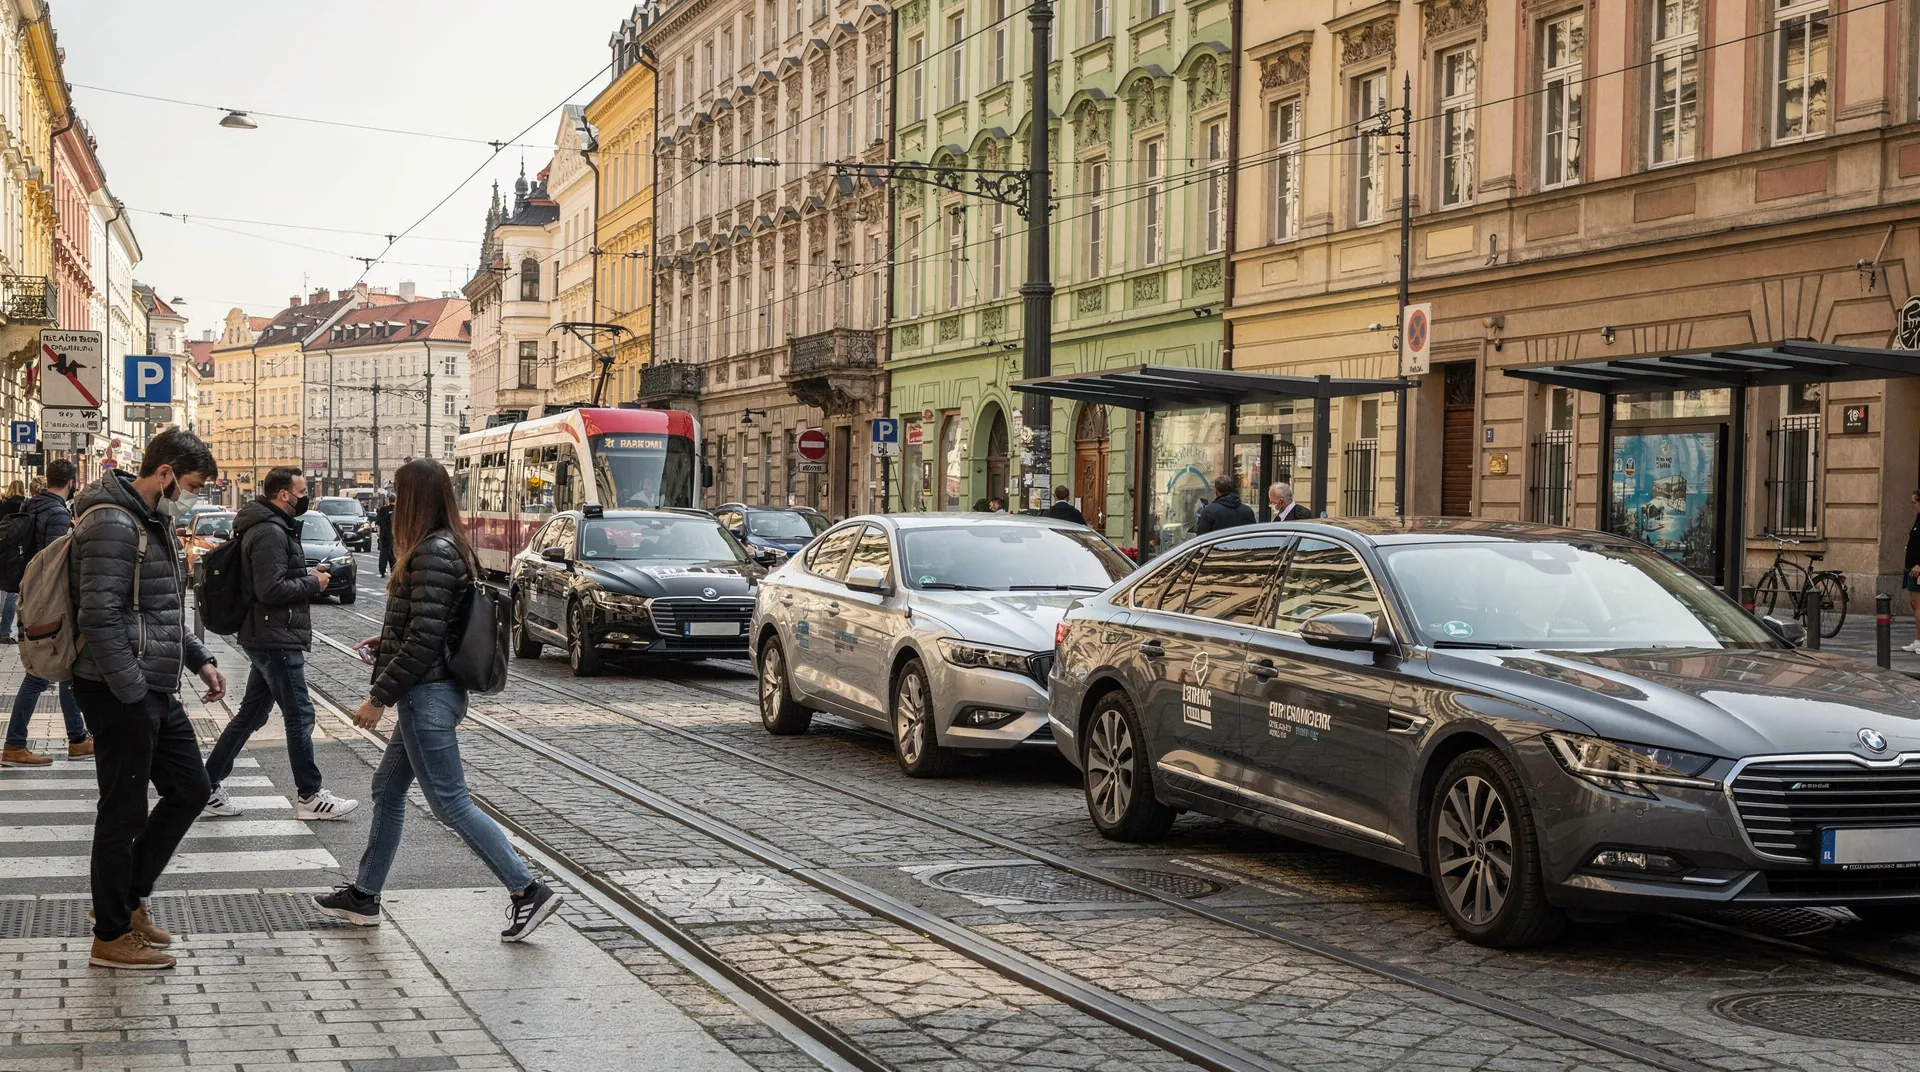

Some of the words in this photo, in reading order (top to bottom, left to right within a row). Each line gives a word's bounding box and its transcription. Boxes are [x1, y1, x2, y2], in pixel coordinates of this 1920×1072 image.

[138, 361, 164, 398] P
[16, 424, 31, 443] P
[879, 421, 893, 441] P
